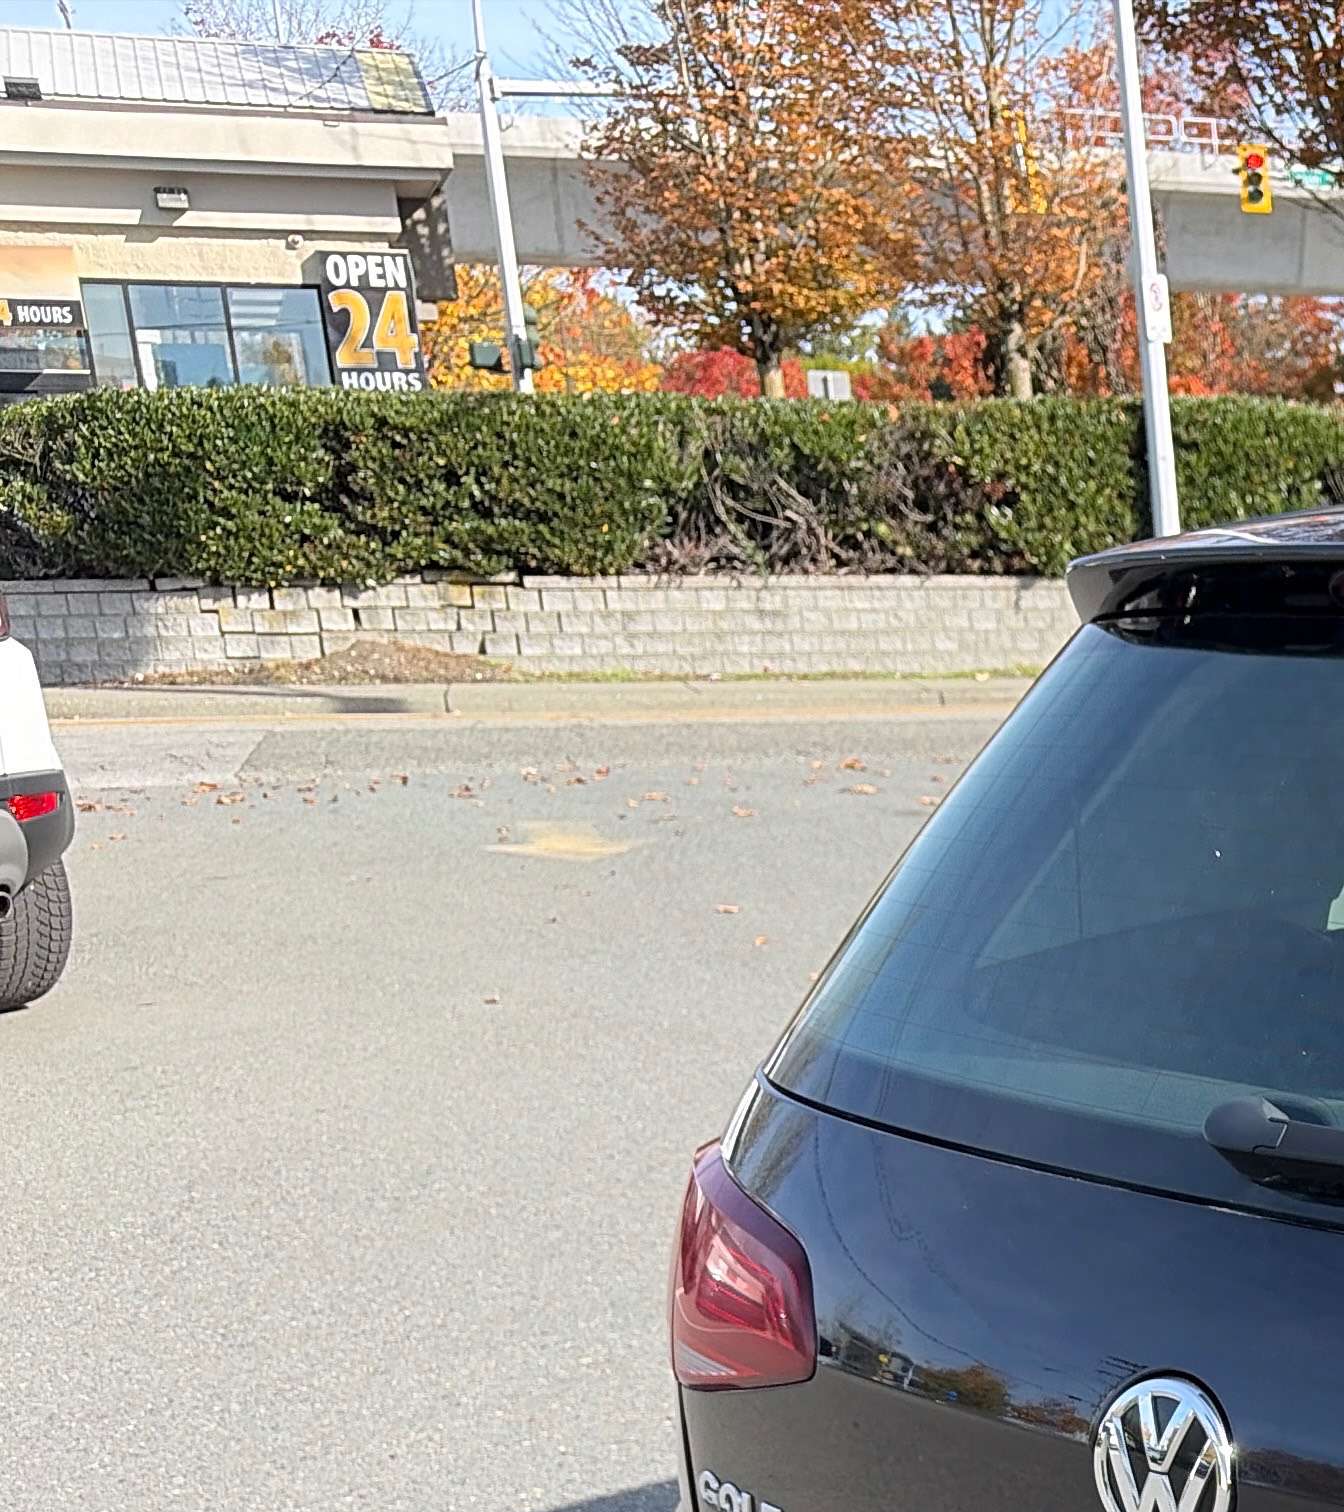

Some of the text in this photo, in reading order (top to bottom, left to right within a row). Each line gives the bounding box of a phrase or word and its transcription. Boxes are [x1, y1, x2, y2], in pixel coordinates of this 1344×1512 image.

[325, 253, 408, 289] OPEN
[16, 305, 73, 324] HOURS
[327, 288, 419, 370] 24
[341, 371, 423, 392] HOURS
